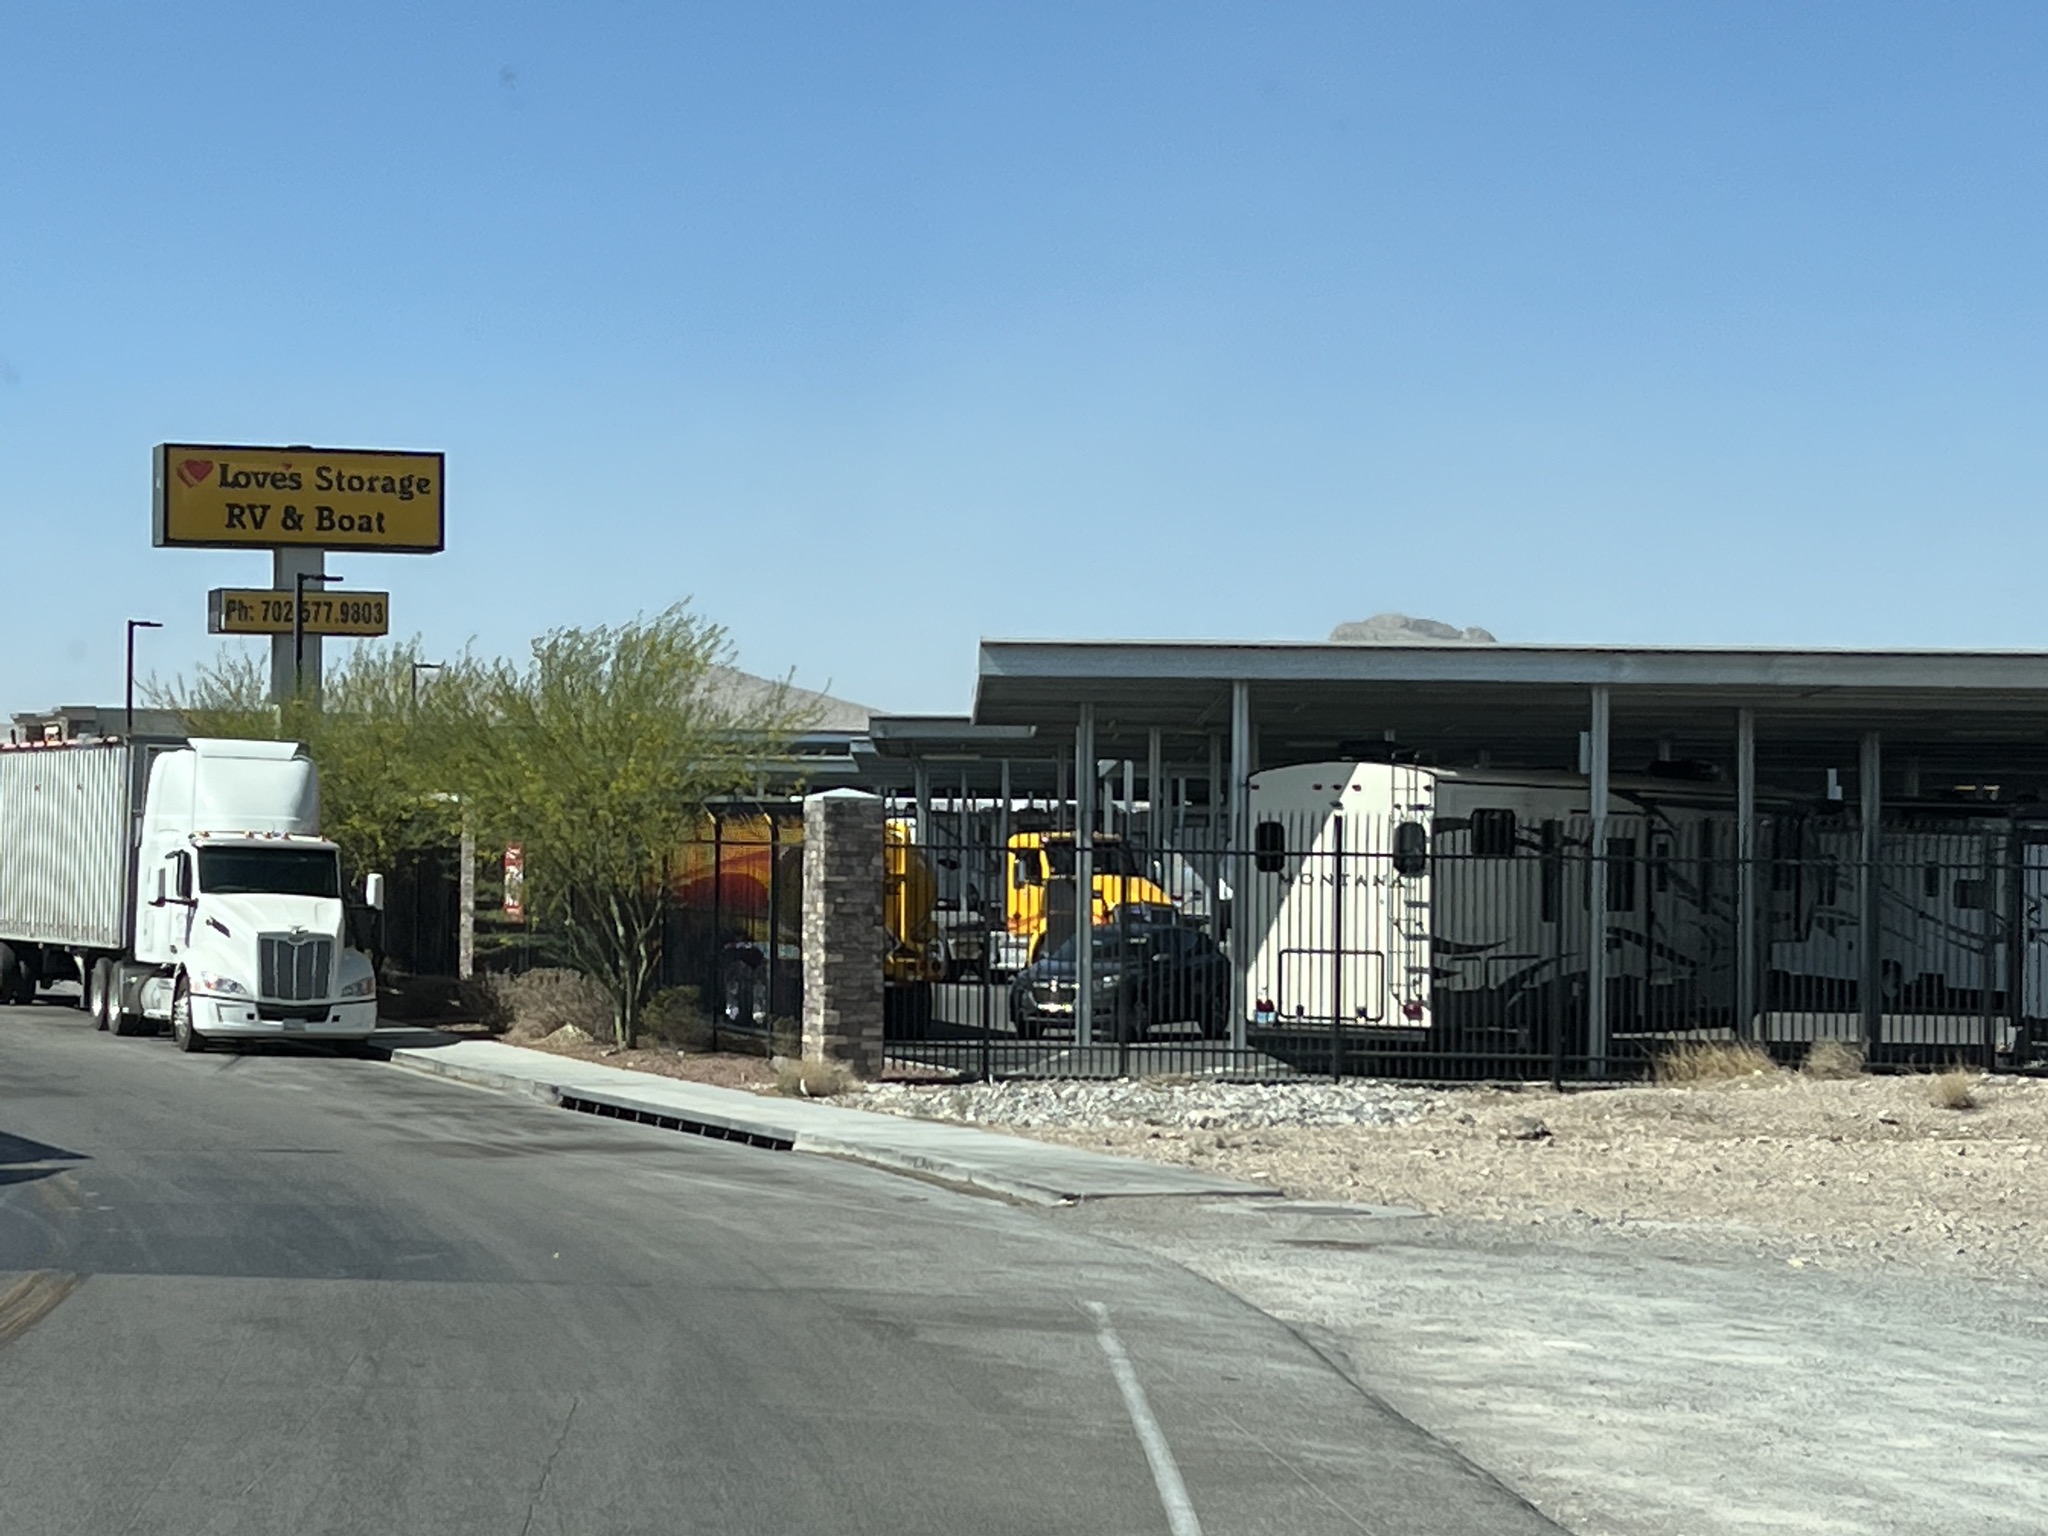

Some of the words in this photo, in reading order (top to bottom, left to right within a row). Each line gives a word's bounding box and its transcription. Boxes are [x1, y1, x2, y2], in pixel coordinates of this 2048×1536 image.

[315, 466, 430, 500] Storage
[225, 503, 270, 529] RV
[281, 505, 304, 531] &
[315, 506, 385, 533] Boat
[226, 600, 254, 622] Ph:
